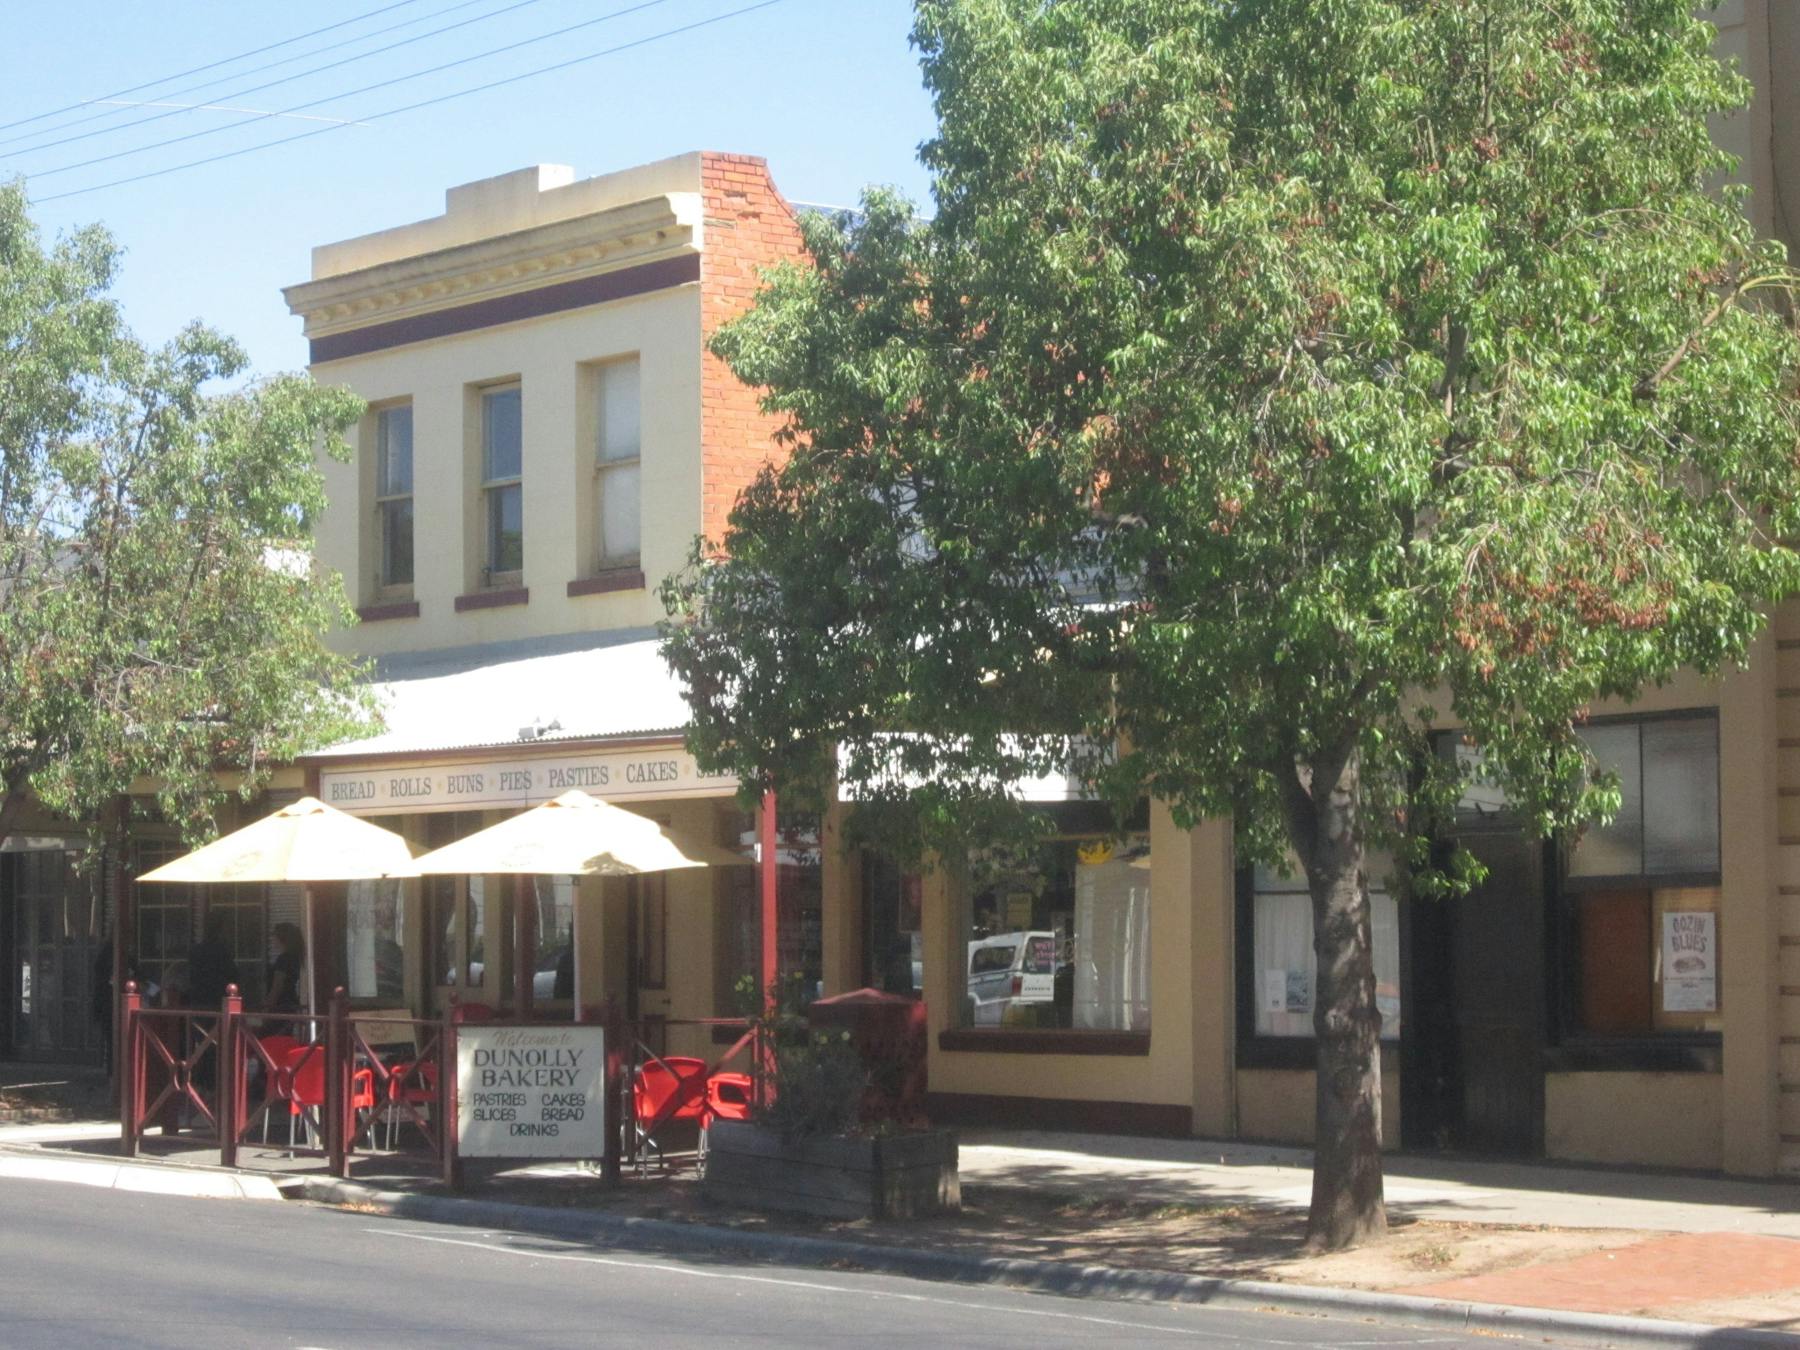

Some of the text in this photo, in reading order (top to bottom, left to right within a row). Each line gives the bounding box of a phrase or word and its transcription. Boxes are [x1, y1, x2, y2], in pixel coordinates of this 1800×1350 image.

[331, 781, 376, 800] BREAD
[389, 777, 432, 797] ROLLS
[447, 774, 484, 794] BUNS
[499, 769, 532, 791] PIES
[548, 766, 609, 788] PASTIES
[626, 760, 678, 783] CAKES
[1671, 933, 1708, 952] BLUES
[493, 1030, 555, 1046] Welcome
[474, 1049, 584, 1067] DUNOLLY
[481, 1069, 581, 1087] BAKERY
[473, 1093, 586, 1107] PASTRIES CAKES
[473, 1108, 584, 1121] SLICES BREAD
[510, 1123, 560, 1137] DRINKS
